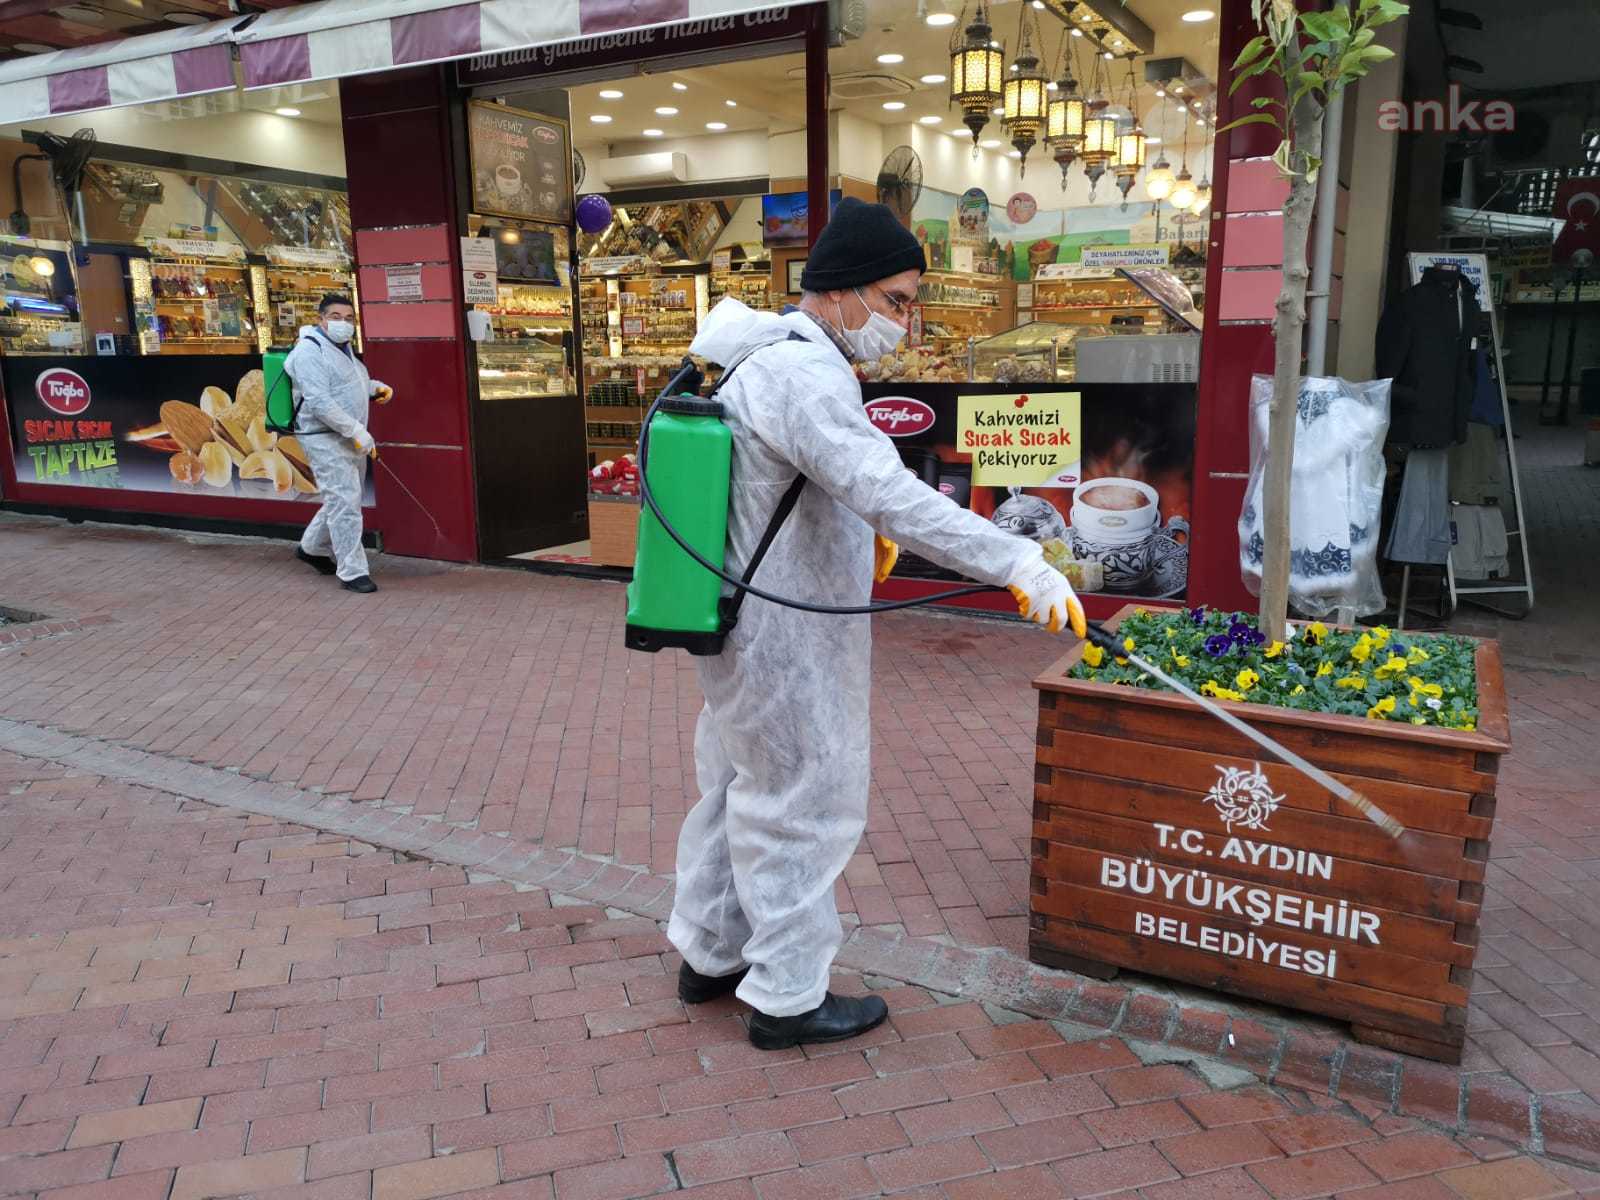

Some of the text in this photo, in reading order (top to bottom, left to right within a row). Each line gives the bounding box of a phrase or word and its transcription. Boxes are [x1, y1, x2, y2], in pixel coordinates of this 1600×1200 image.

[24, 419, 76, 443] SICAK
[974, 409, 1060, 427] Kahvemizi
[964, 428, 1071, 447] Sıcak Sıcak
[28, 440, 118, 481] TAPTAZE
[978, 450, 1058, 468] Çekiyoruz
[1153, 822, 1333, 880] T.C. AYDIN
[1101, 857, 1381, 945] BÜYÜKŞEHİR
[1135, 911, 1337, 978] BELEDİYESİ
